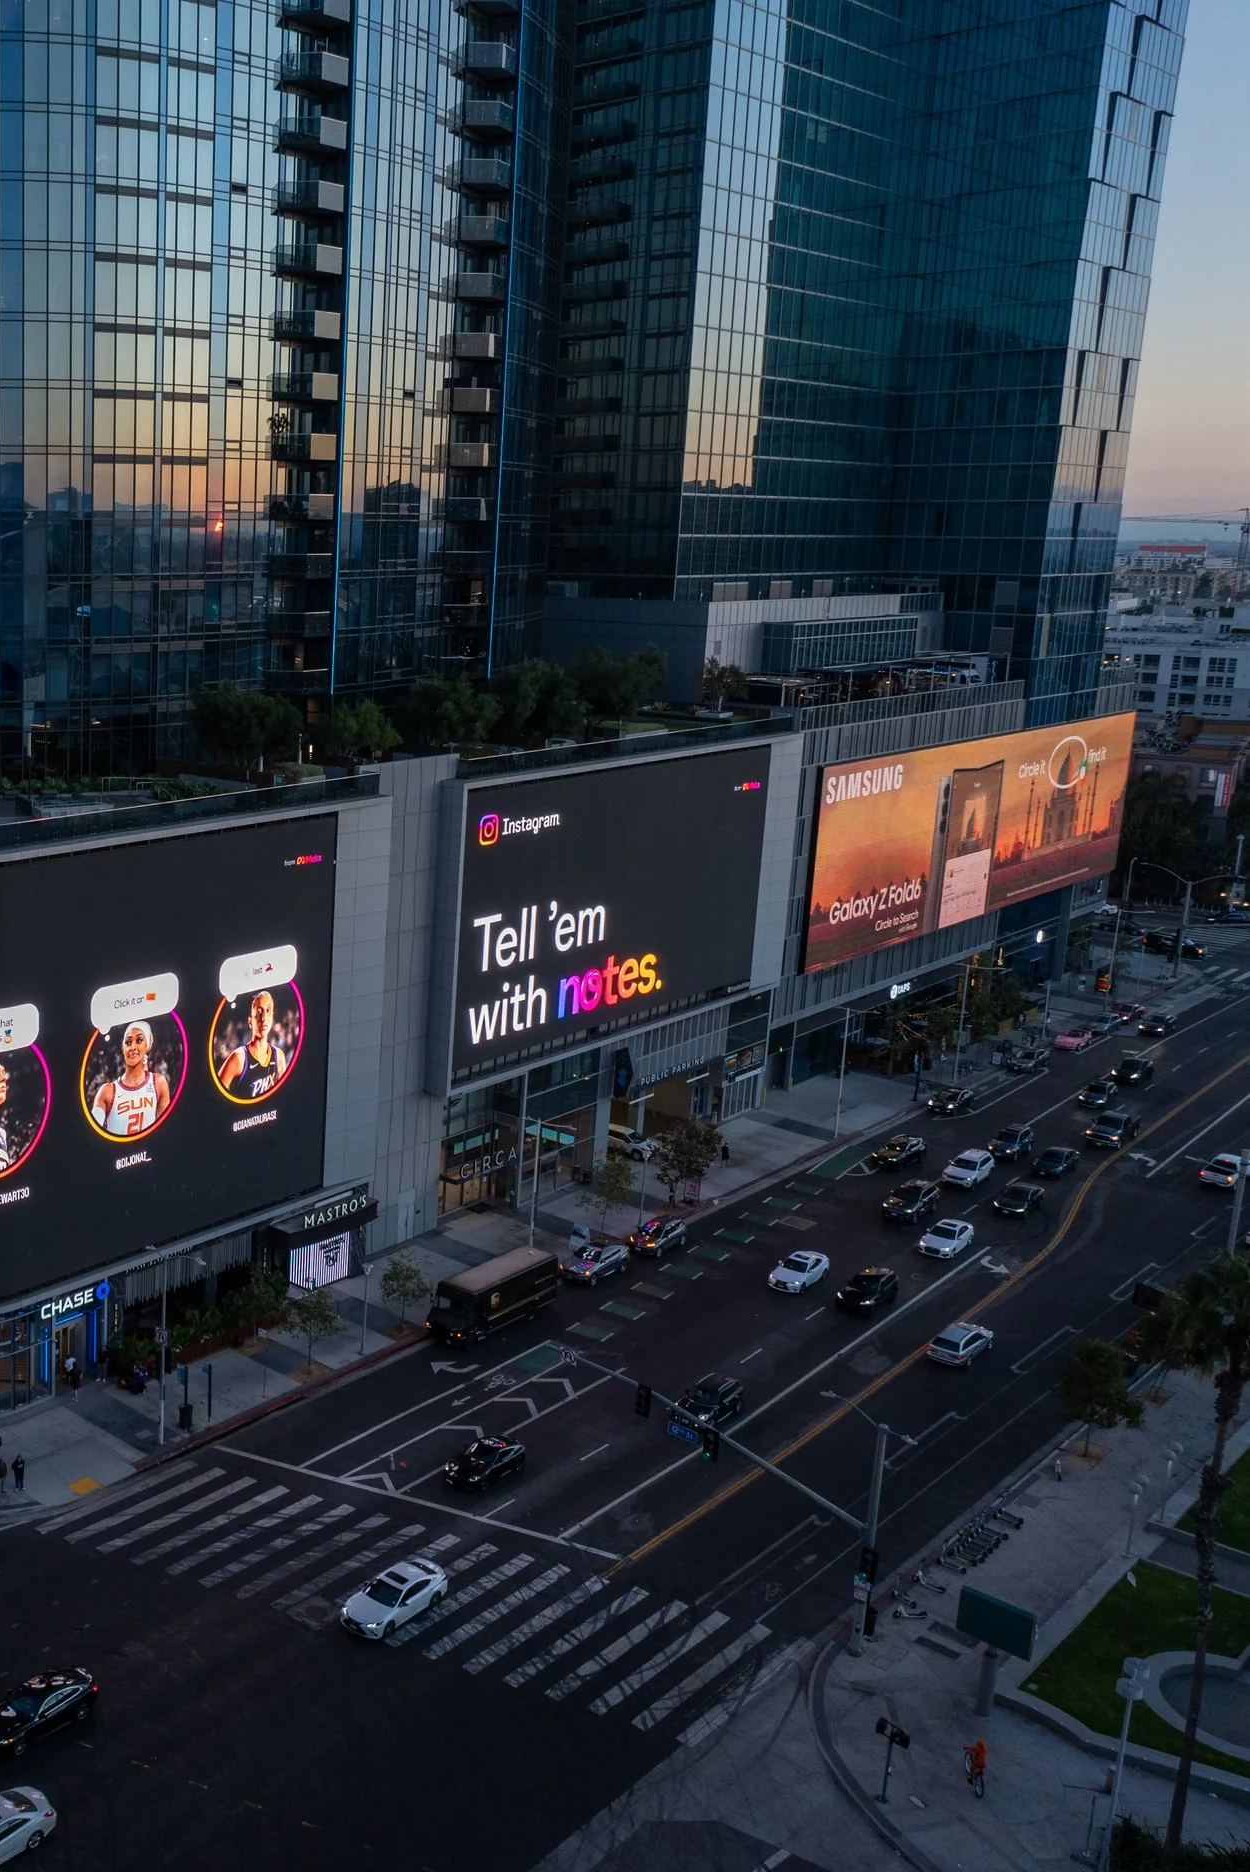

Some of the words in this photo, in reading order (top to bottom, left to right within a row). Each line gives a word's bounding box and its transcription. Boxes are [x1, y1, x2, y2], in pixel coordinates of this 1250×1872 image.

[825, 764, 904, 804] SAMSUNG
[1018, 762, 1039, 779] Circle
[1040, 760, 1046, 775] it
[502, 813, 560, 835] Instagram
[829, 894, 879, 925] Galaxy
[878, 887, 888, 910] Z
[888, 878, 922, 908] Fold6
[473, 905, 538, 972] Tell
[548, 901, 607, 952] 'em
[875, 918, 892, 932] Circle
[893, 916, 899, 926] to
[900, 909, 919, 924] Search
[114, 998, 131, 1009] Click
[137, 996, 144, 1004] or
[469, 975, 547, 1045] with
[557, 953, 662, 1019] notes.
[640, 1069, 668, 1086] PUBLIC
[672, 1056, 705, 1074] PARKING
[117, 1096, 154, 1115] SUN
[459, 1146, 518, 1179] CIRCA
[304, 1194, 367, 1229] MASTRO'S
[40, 1288, 95, 1320] CHASE
